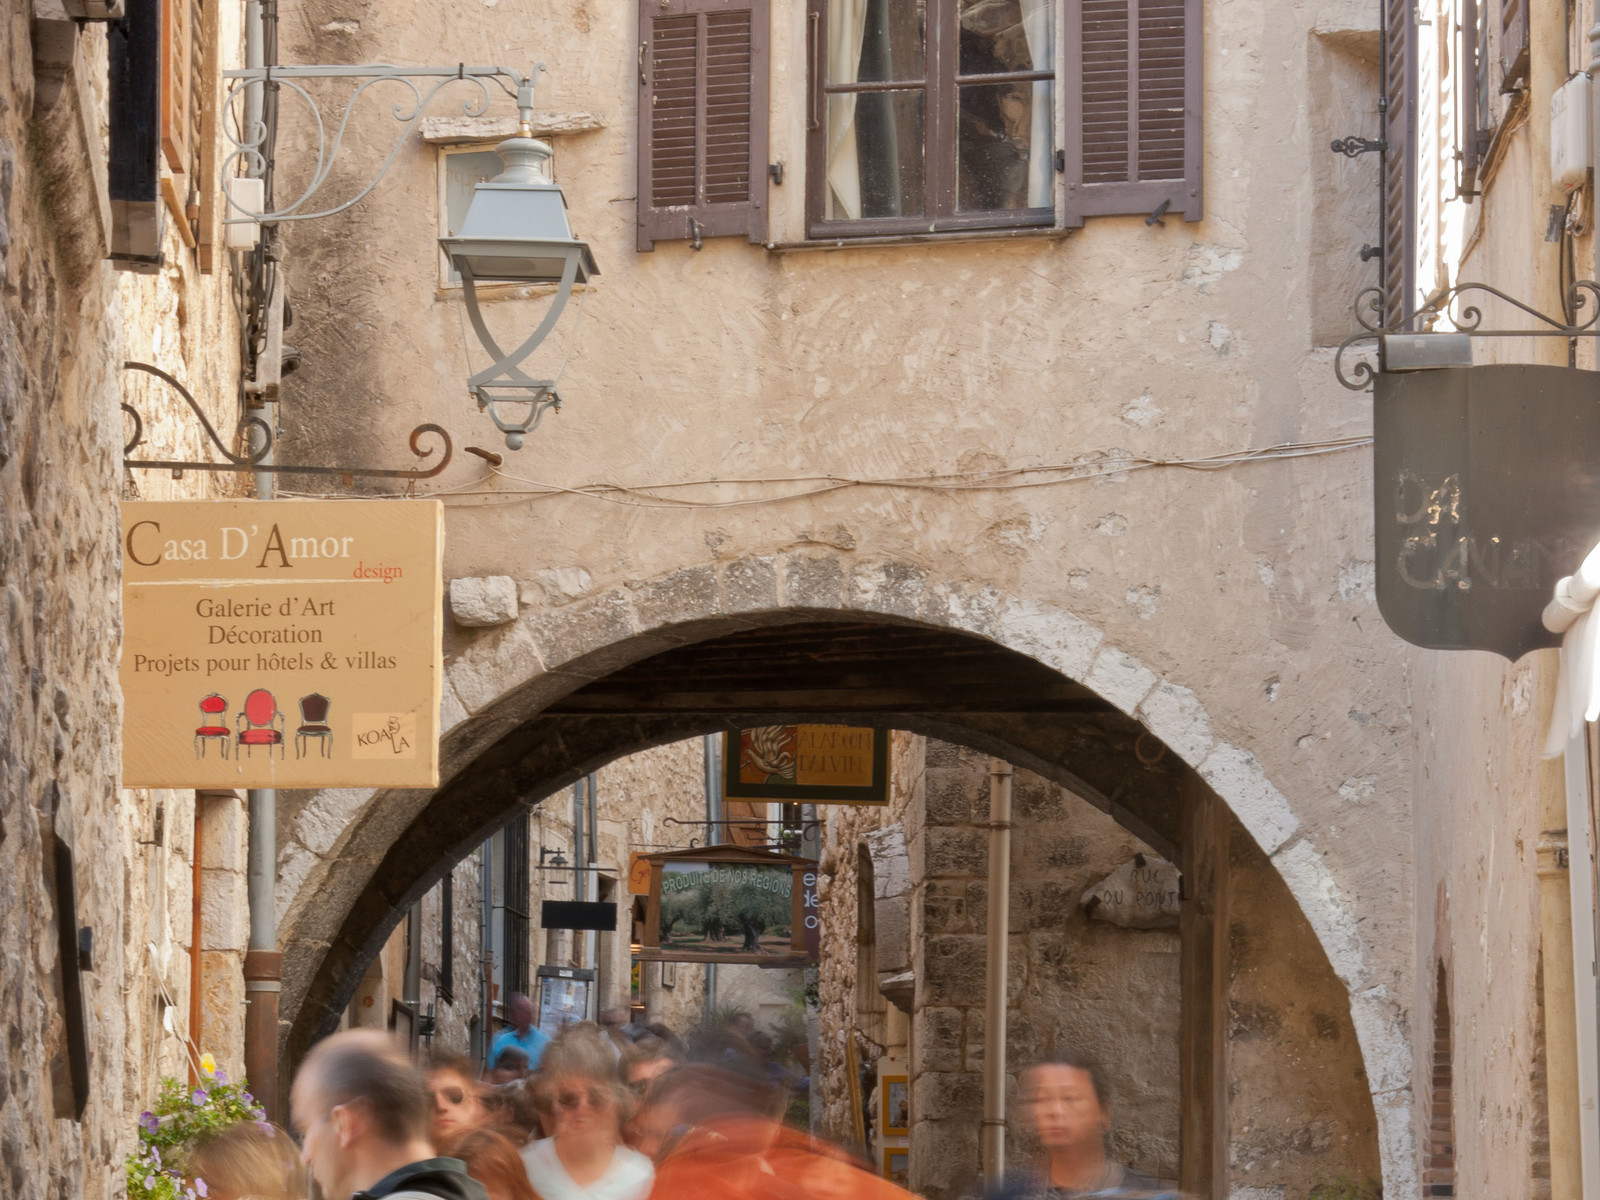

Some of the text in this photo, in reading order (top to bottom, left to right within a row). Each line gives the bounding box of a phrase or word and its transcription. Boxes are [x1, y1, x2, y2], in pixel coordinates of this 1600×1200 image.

[126, 521, 208, 566] Casa
[353, 562, 403, 583] design
[196, 599, 272, 618] Galerie
[208, 626, 322, 645] Décoration
[134, 652, 396, 677] Projets pour hôtels & villas
[662, 871, 710, 895] PRODUITS
[713, 871, 725, 882] DE
[729, 871, 747, 884] NOS
[1136, 892, 1176, 906] PONT
